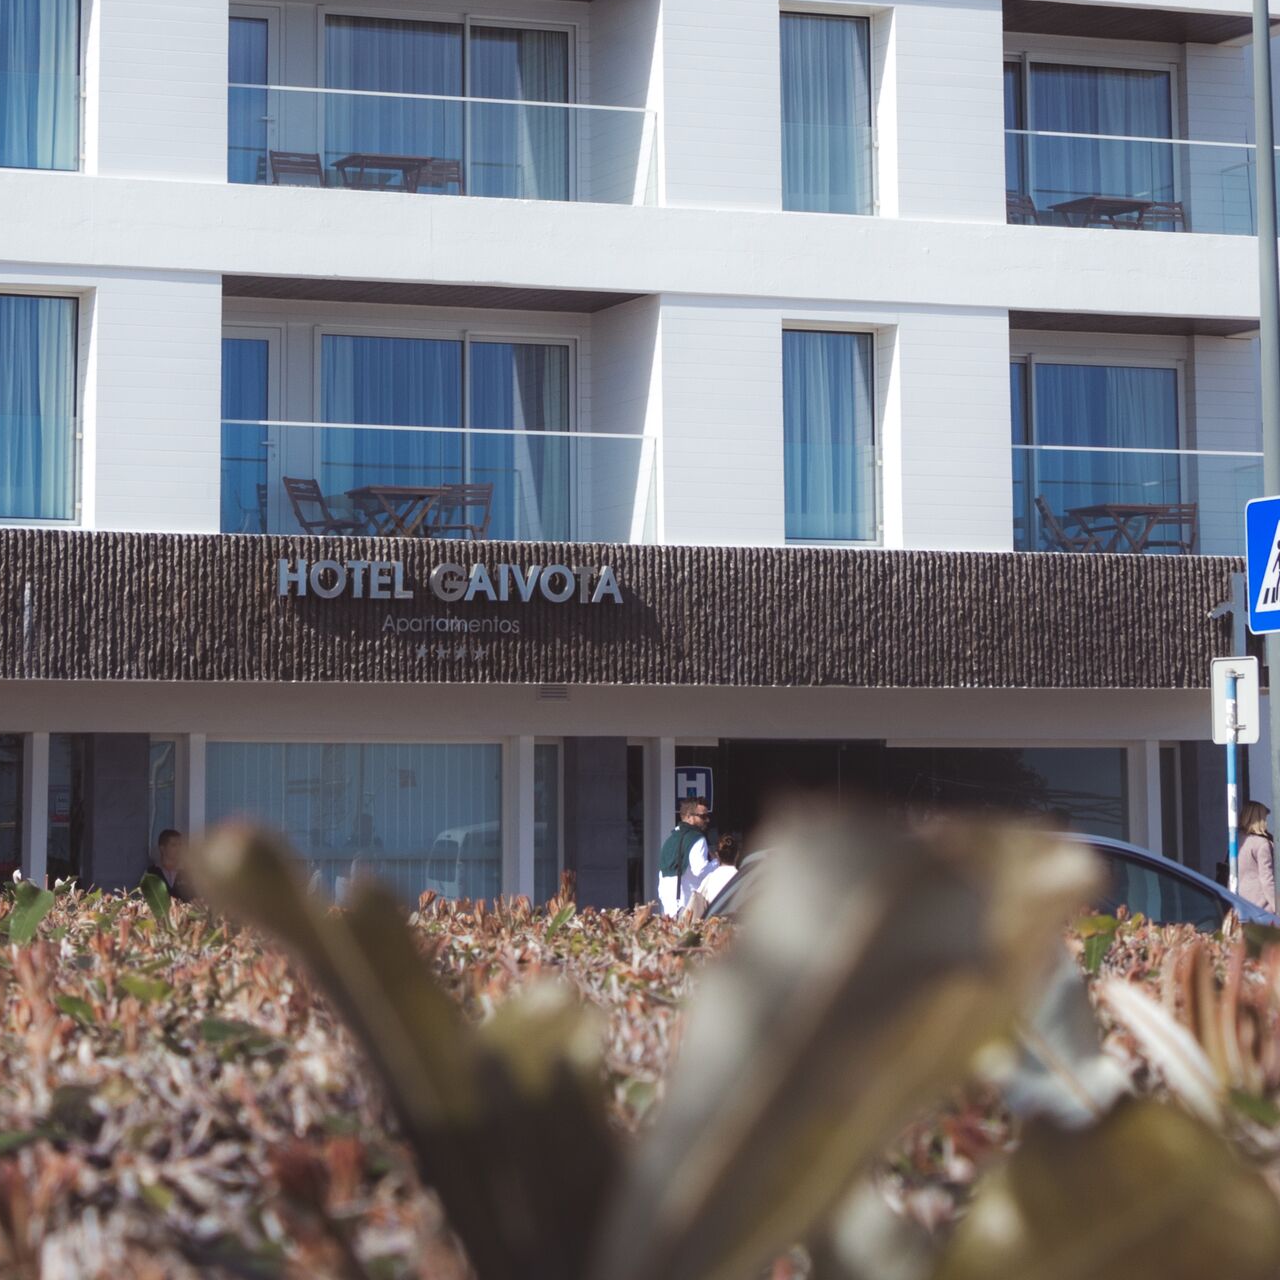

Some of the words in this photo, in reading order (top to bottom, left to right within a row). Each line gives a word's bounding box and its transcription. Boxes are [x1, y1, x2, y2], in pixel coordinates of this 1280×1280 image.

[278, 558, 414, 599] HOTEL
[430, 563, 624, 604] GAIVOTA
[382, 613, 521, 635] Apartamentos
[677, 773, 706, 798] H
